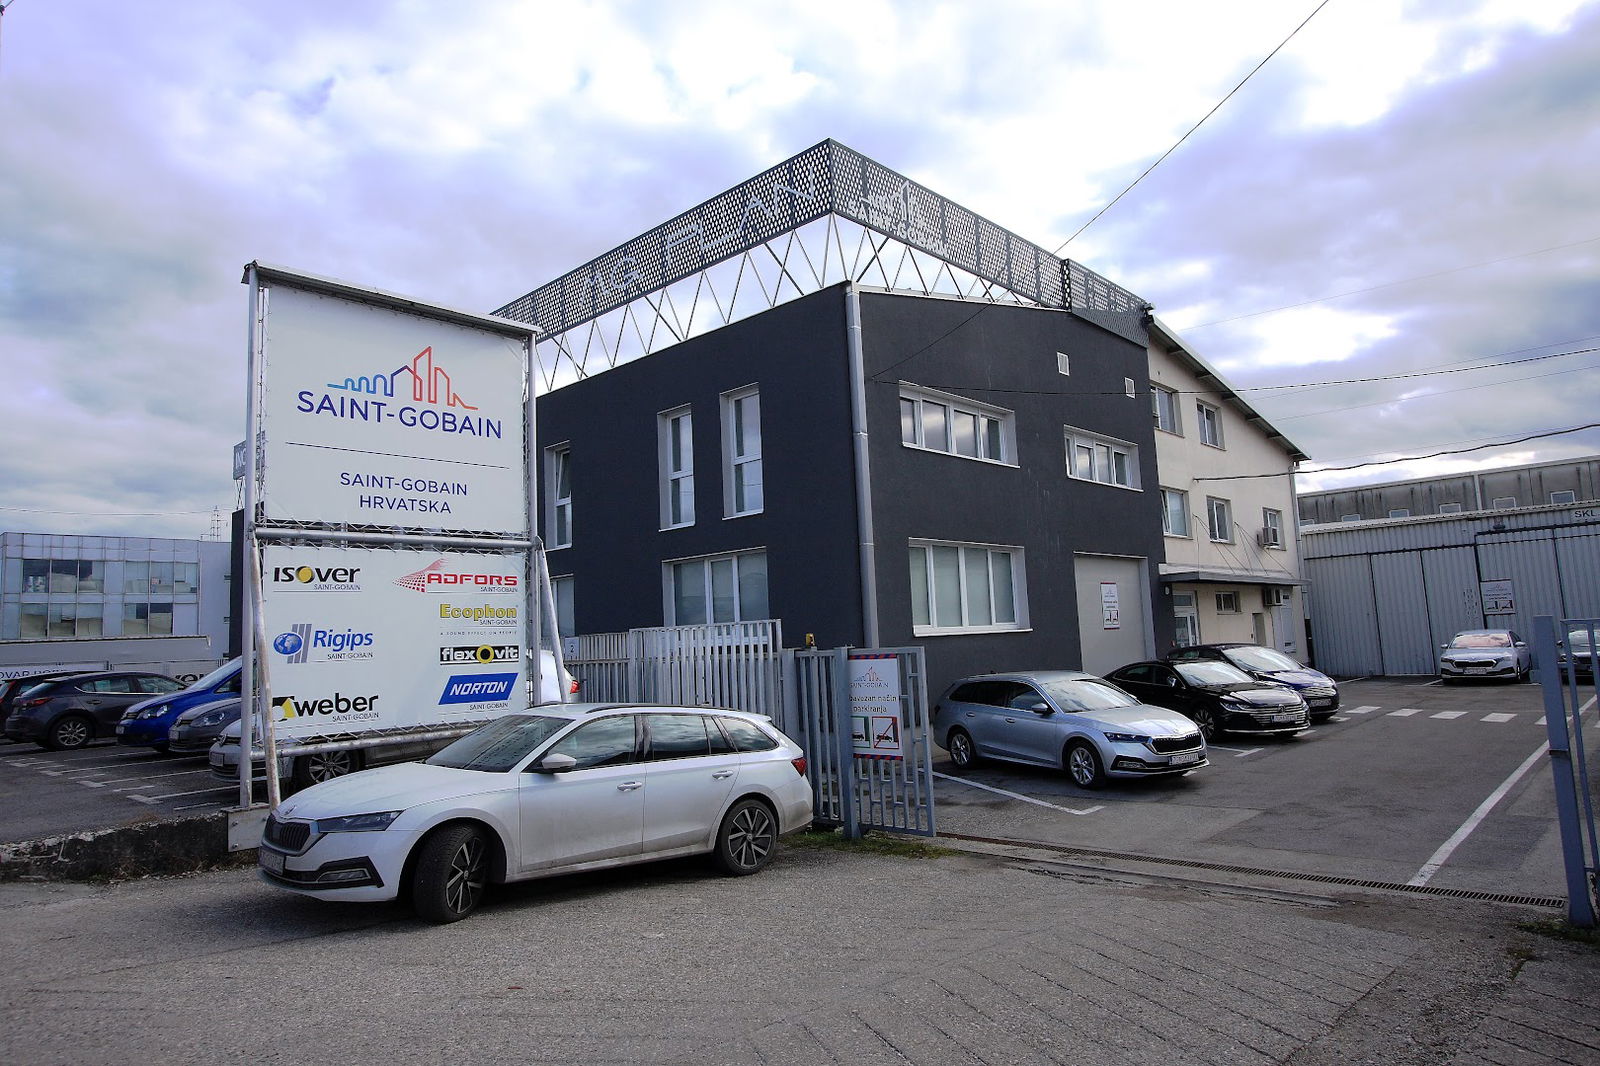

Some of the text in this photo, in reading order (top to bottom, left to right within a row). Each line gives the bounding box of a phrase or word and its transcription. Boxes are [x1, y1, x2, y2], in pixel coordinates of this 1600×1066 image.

[667, 166, 815, 266] PLAN
[297, 390, 501, 438] SAINT-GOBAIN
[340, 472, 467, 495] SAINT-GOBAIN
[359, 495, 452, 514] HRVATSKA
[427, 573, 517, 586] ADFORS
[440, 604, 517, 621] Ecophon
[313, 629, 373, 651] Rigips
[450, 681, 508, 696] NORTON
[293, 693, 378, 716] weber
